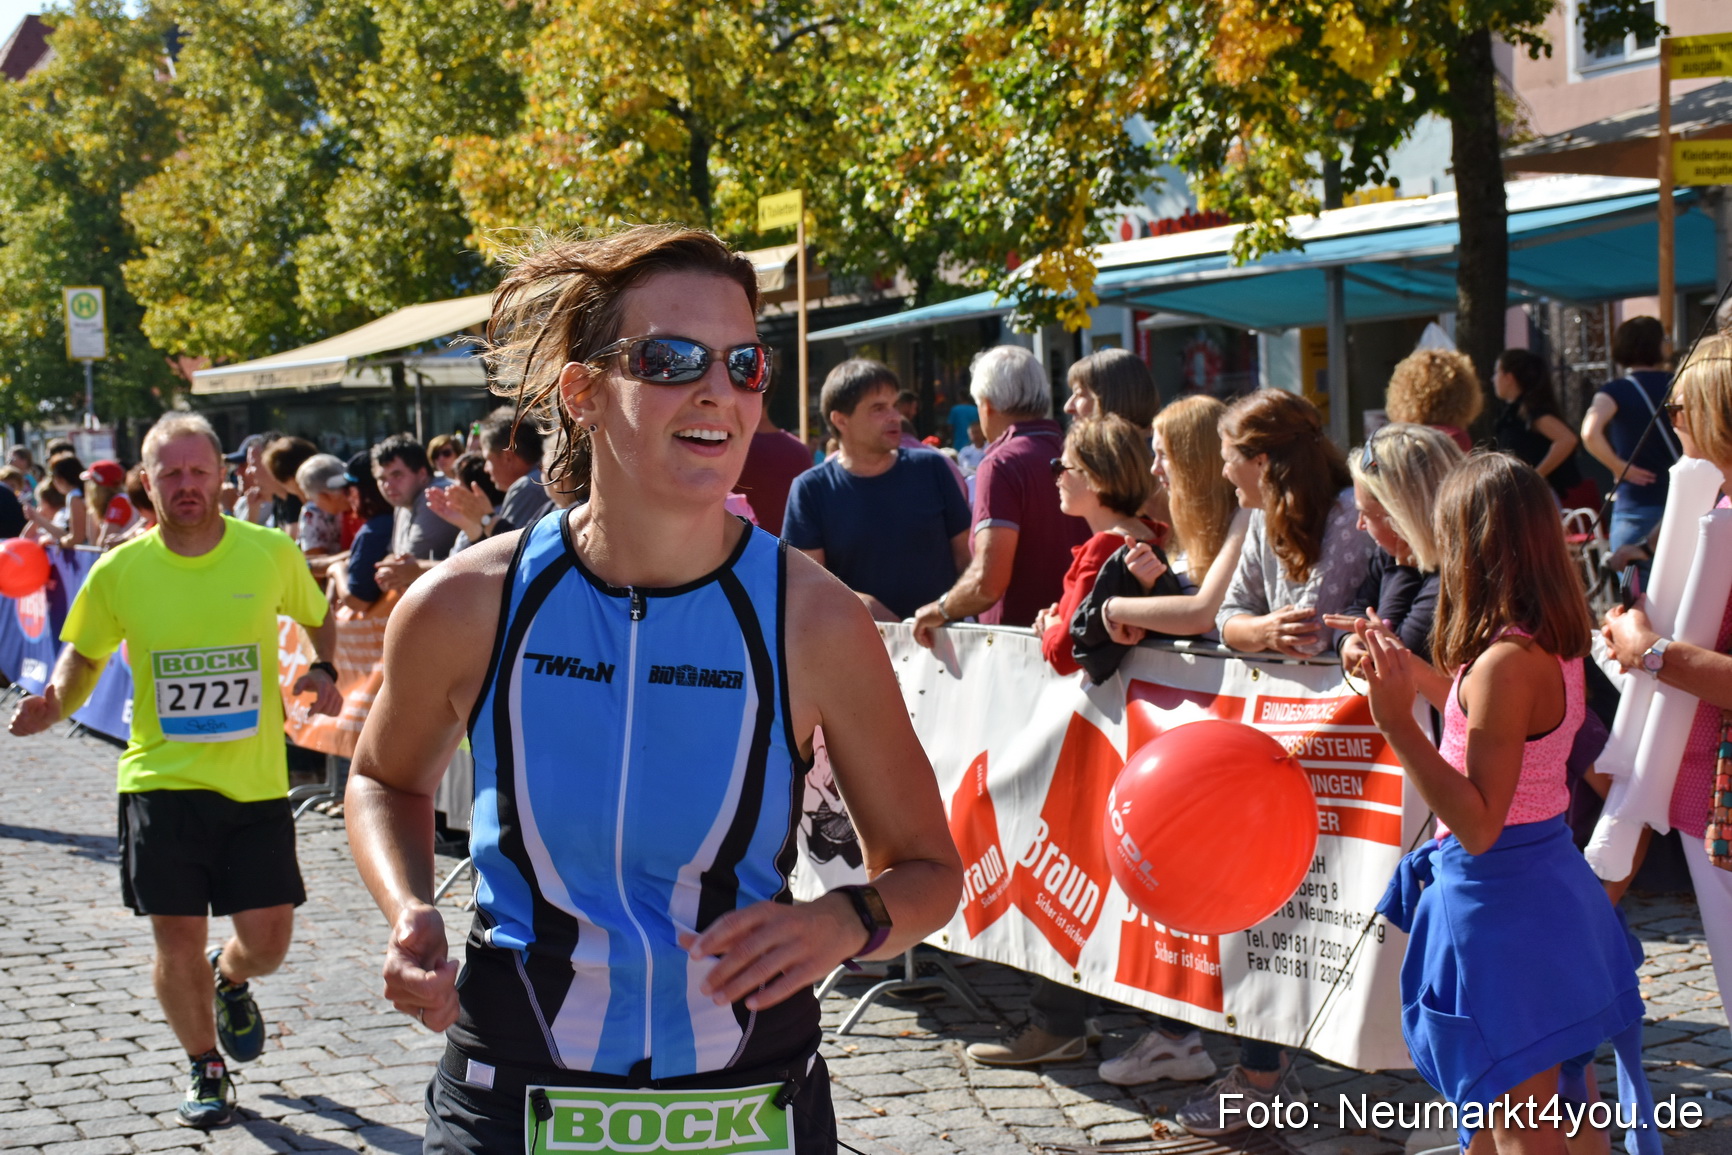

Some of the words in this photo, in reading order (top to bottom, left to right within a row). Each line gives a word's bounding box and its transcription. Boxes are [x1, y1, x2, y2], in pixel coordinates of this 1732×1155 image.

[161, 649, 250, 674] BOCK
[168, 678, 249, 711] 2727
[1310, 773, 1363, 796] INGEN
[1017, 816, 1100, 926] Braun
[1295, 882, 1327, 904] berg
[1331, 882, 1338, 901] 8
[1035, 892, 1057, 919] Sicher
[1054, 912, 1067, 929] ist
[1244, 930, 1269, 948] Tel.
[1272, 932, 1308, 955] 09181
[1154, 940, 1179, 965] Sicher
[1181, 949, 1194, 968] ist
[1194, 954, 1220, 977] sicher
[1247, 952, 1271, 972] Fax
[1274, 956, 1308, 978] 09181
[549, 1097, 766, 1150] BOCK
